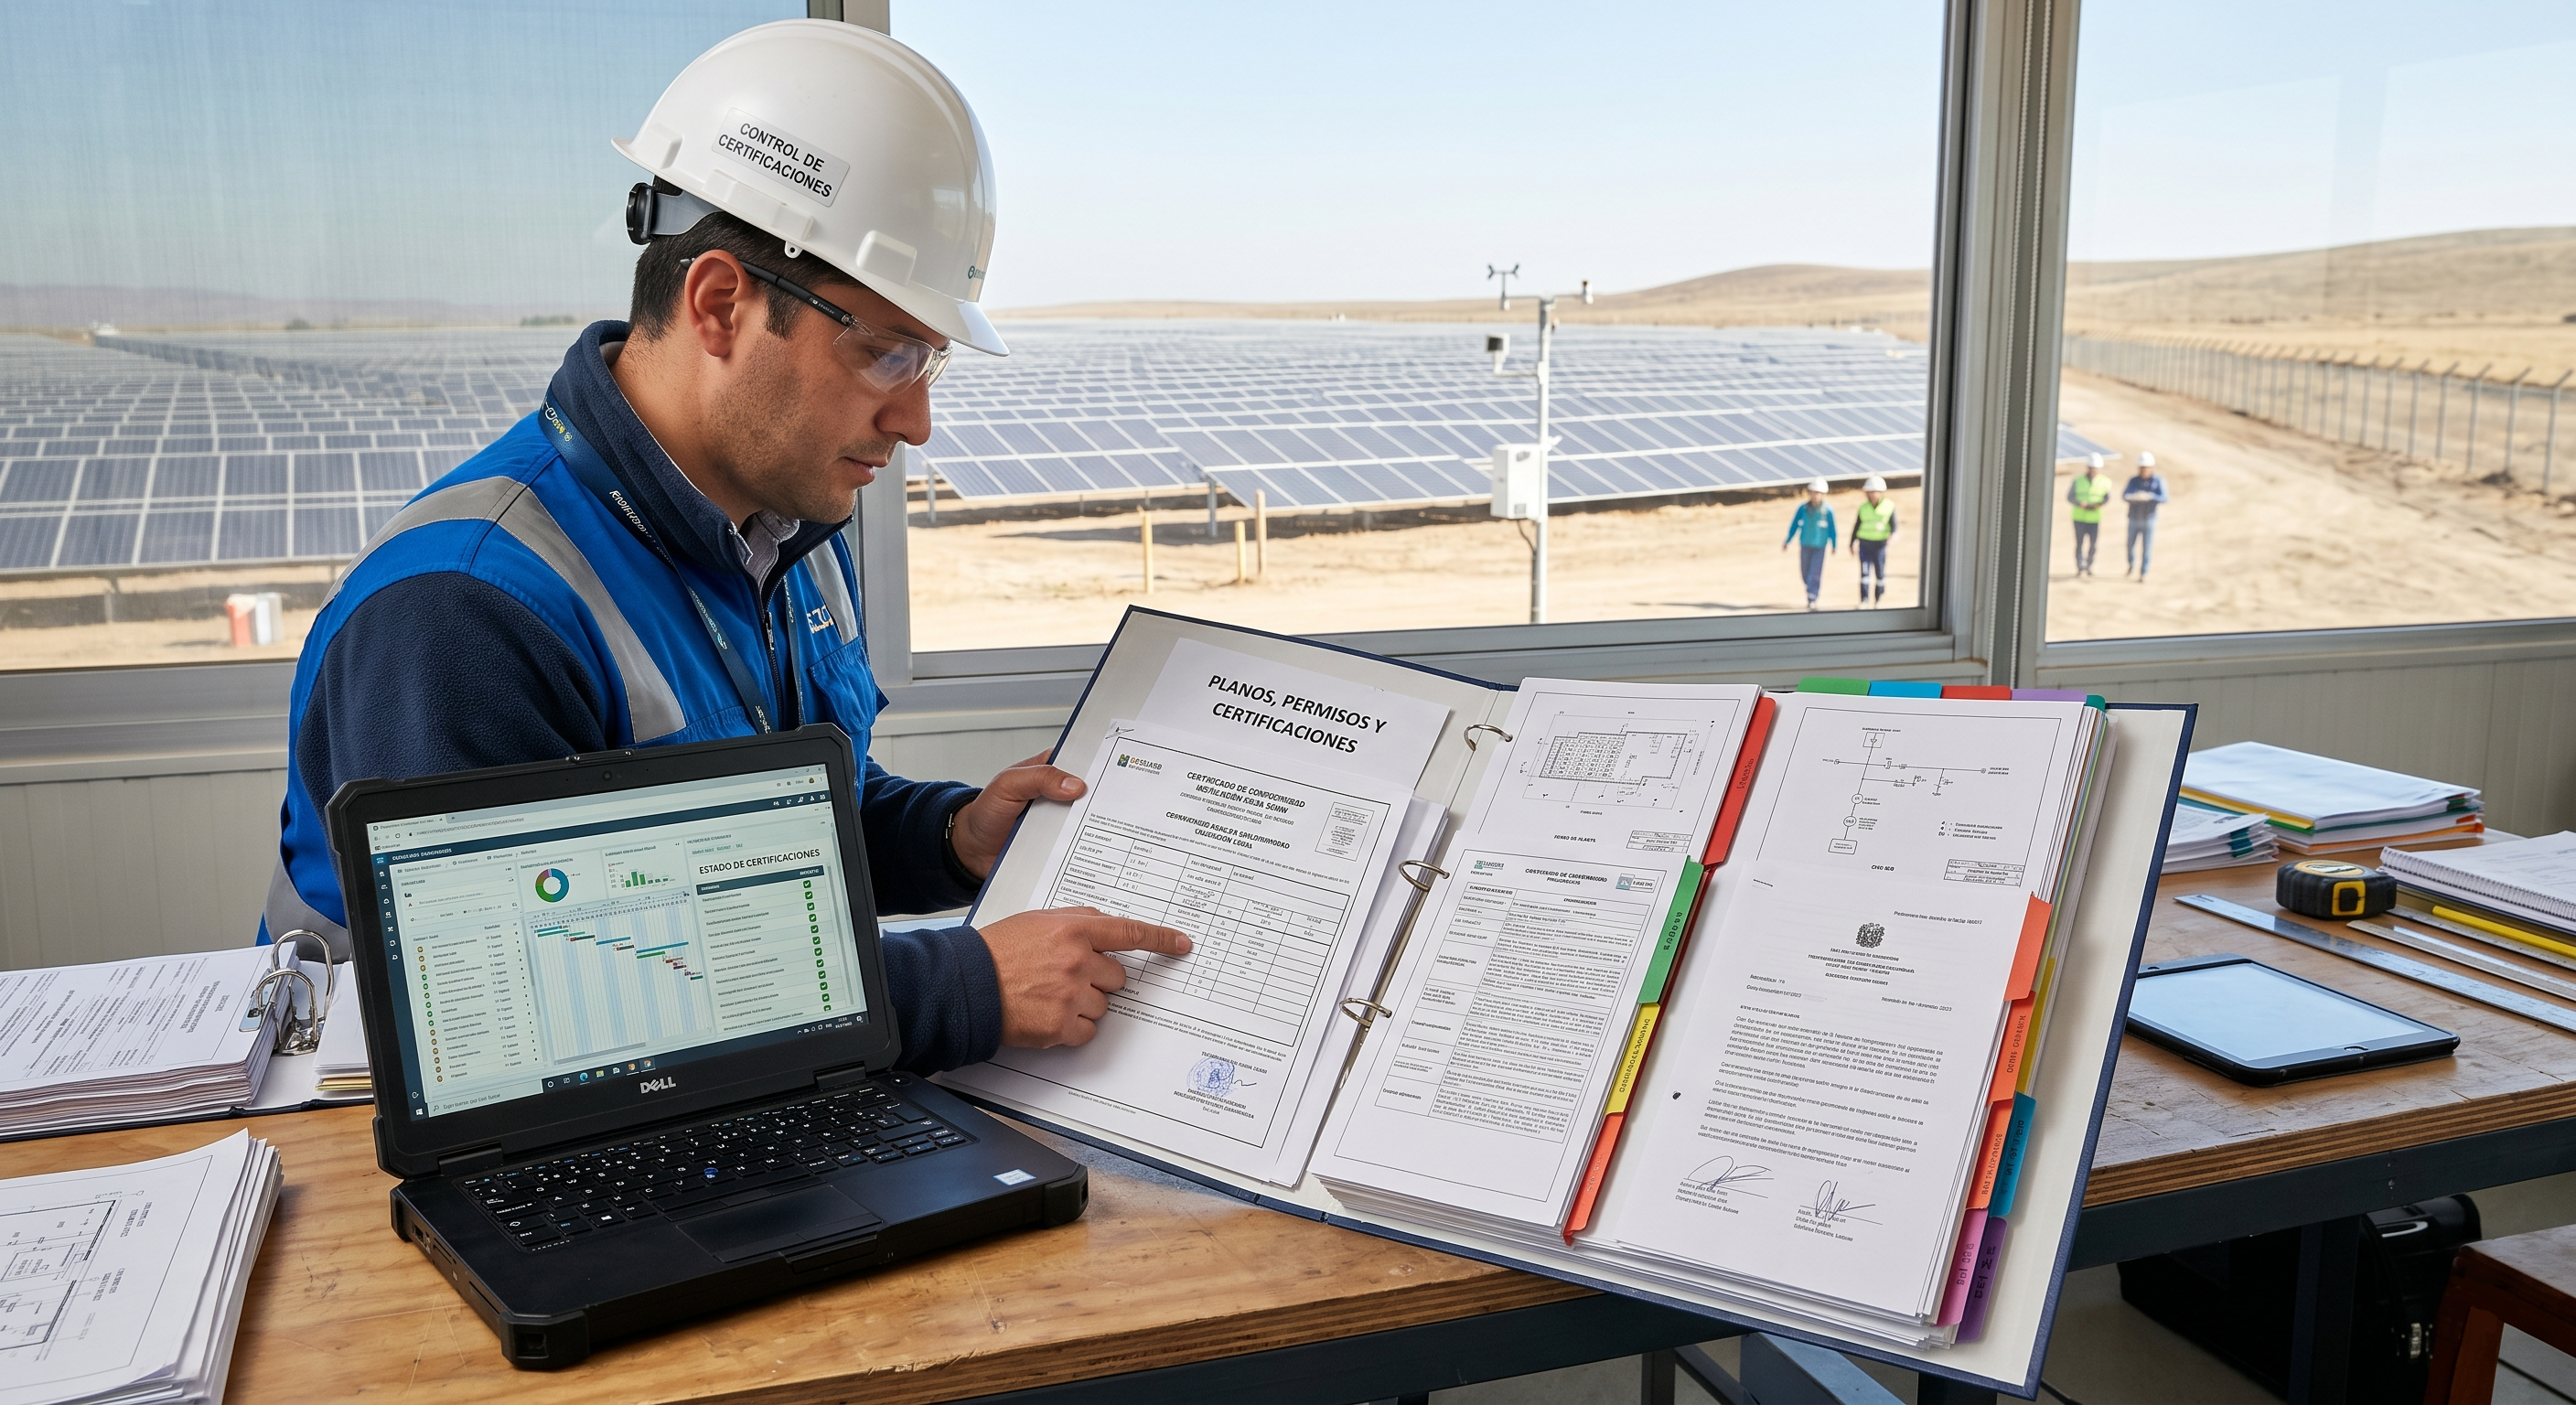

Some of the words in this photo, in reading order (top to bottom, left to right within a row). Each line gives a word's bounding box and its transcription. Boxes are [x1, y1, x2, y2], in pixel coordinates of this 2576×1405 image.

[718, 134, 832, 198] CERTIFICACIONES
[740, 123, 800, 162] CONTROL
[794, 153, 825, 172] DE
[1208, 674, 1277, 707] PLANOS,
[1281, 694, 1371, 730] PERMISOS
[1374, 719, 1388, 734] Y
[1212, 702, 1358, 754] CERTIFICACIONES
[699, 862, 732, 874] ESTADO
[734, 860, 746, 870] DE
[746, 848, 821, 867] CERTIFICACIONES
[640, 1076, 676, 1094] DELL
